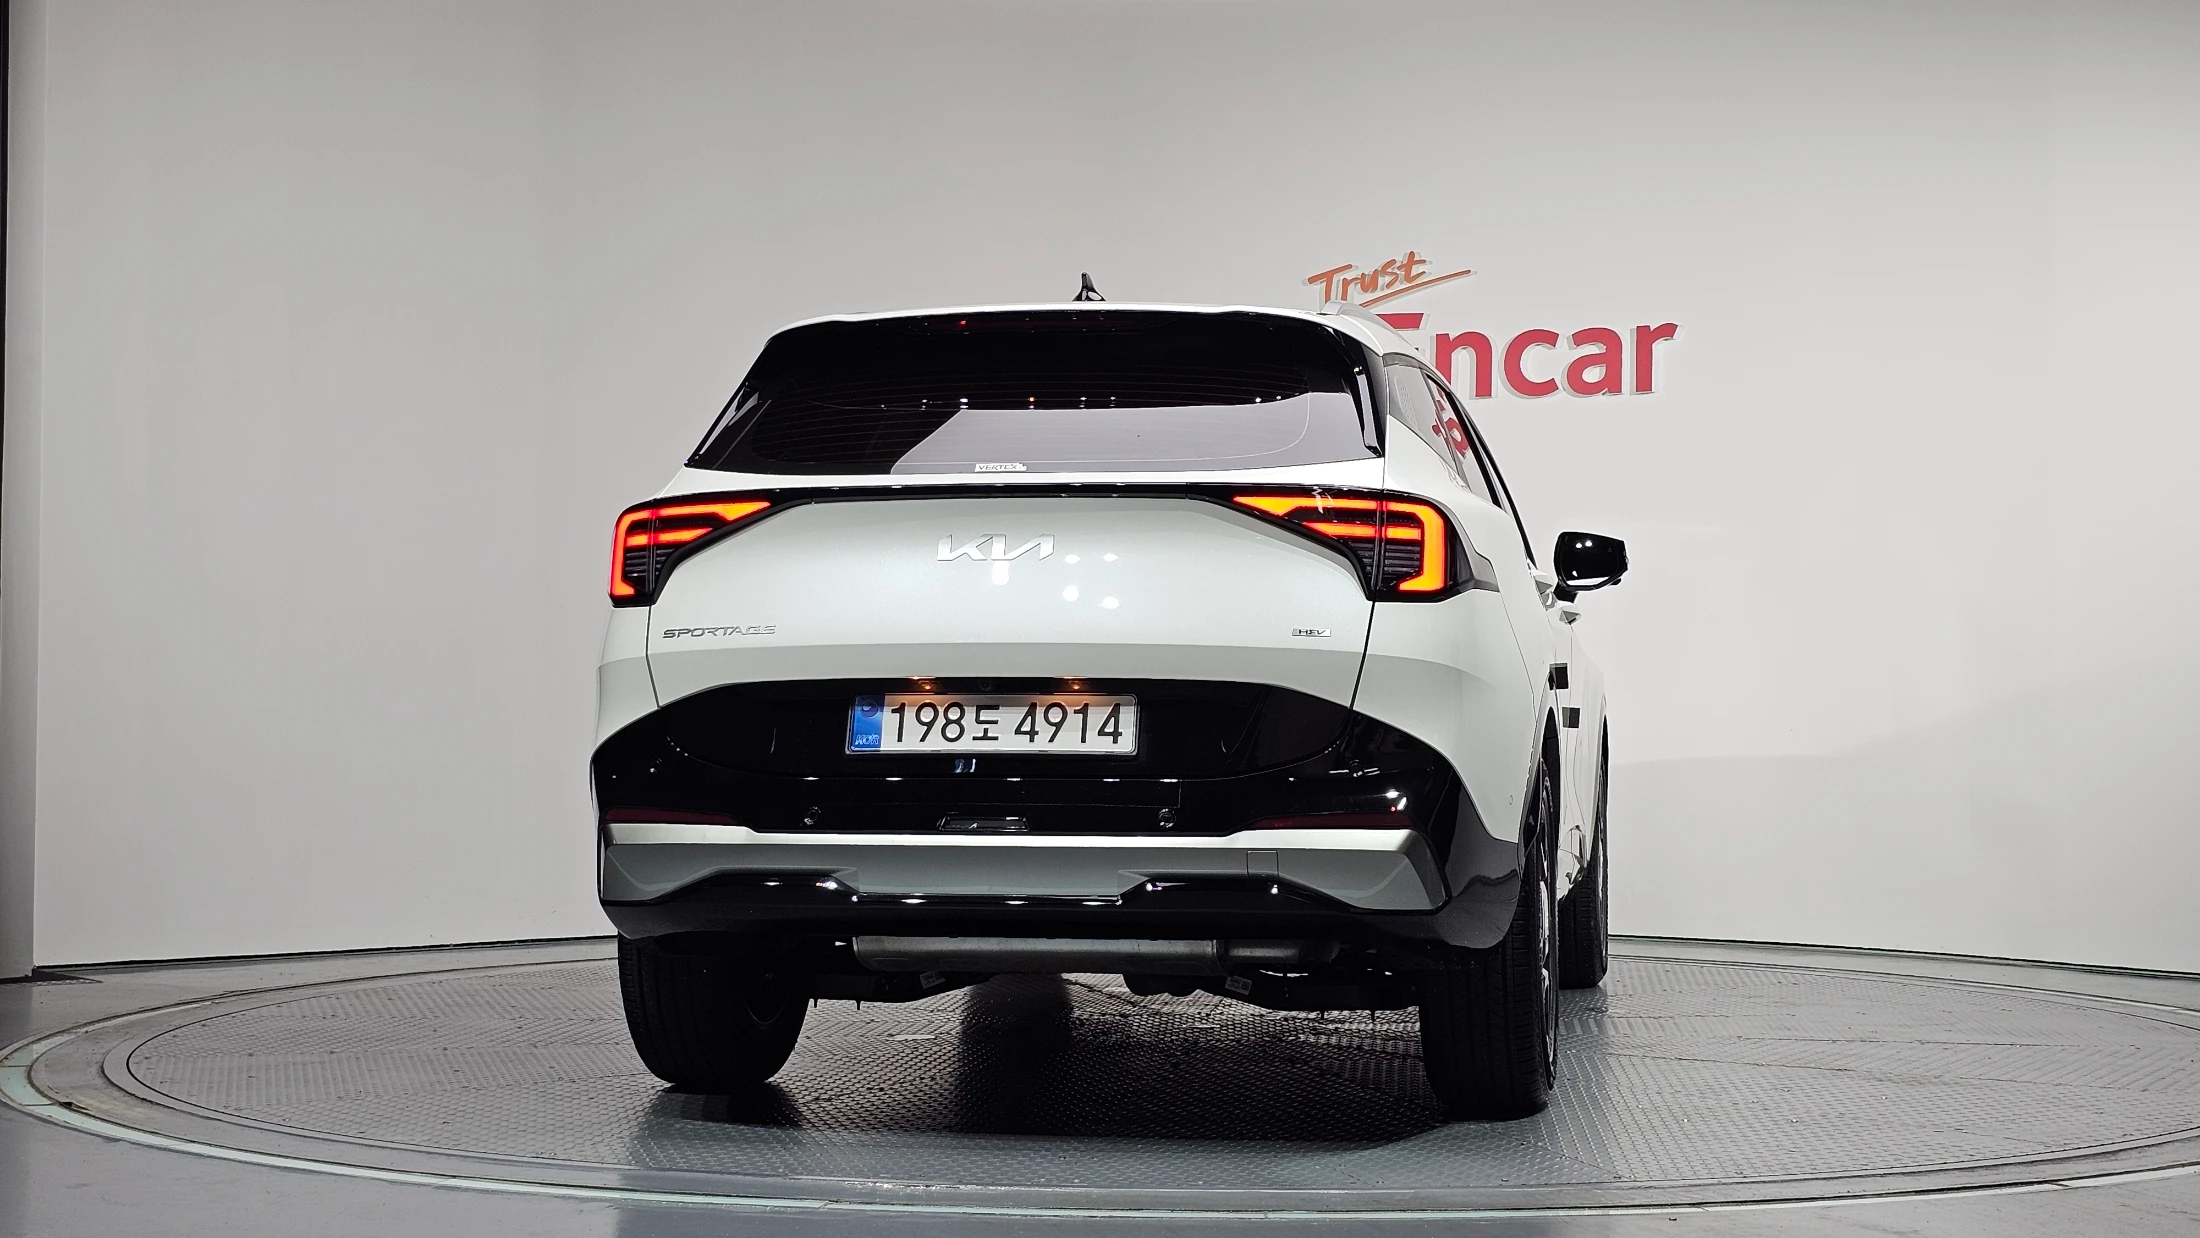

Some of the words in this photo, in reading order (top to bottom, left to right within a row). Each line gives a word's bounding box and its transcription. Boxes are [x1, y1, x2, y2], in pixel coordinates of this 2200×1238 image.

[1307, 250, 1427, 303] Trust
[978, 463, 1018, 471] VERTEX
[937, 533, 1055, 561] KIA
[662, 625, 777, 639] SPORTAGE
[1298, 628, 1327, 636] HEV
[890, 701, 1001, 743] 198도
[1013, 701, 1123, 744] 4914
